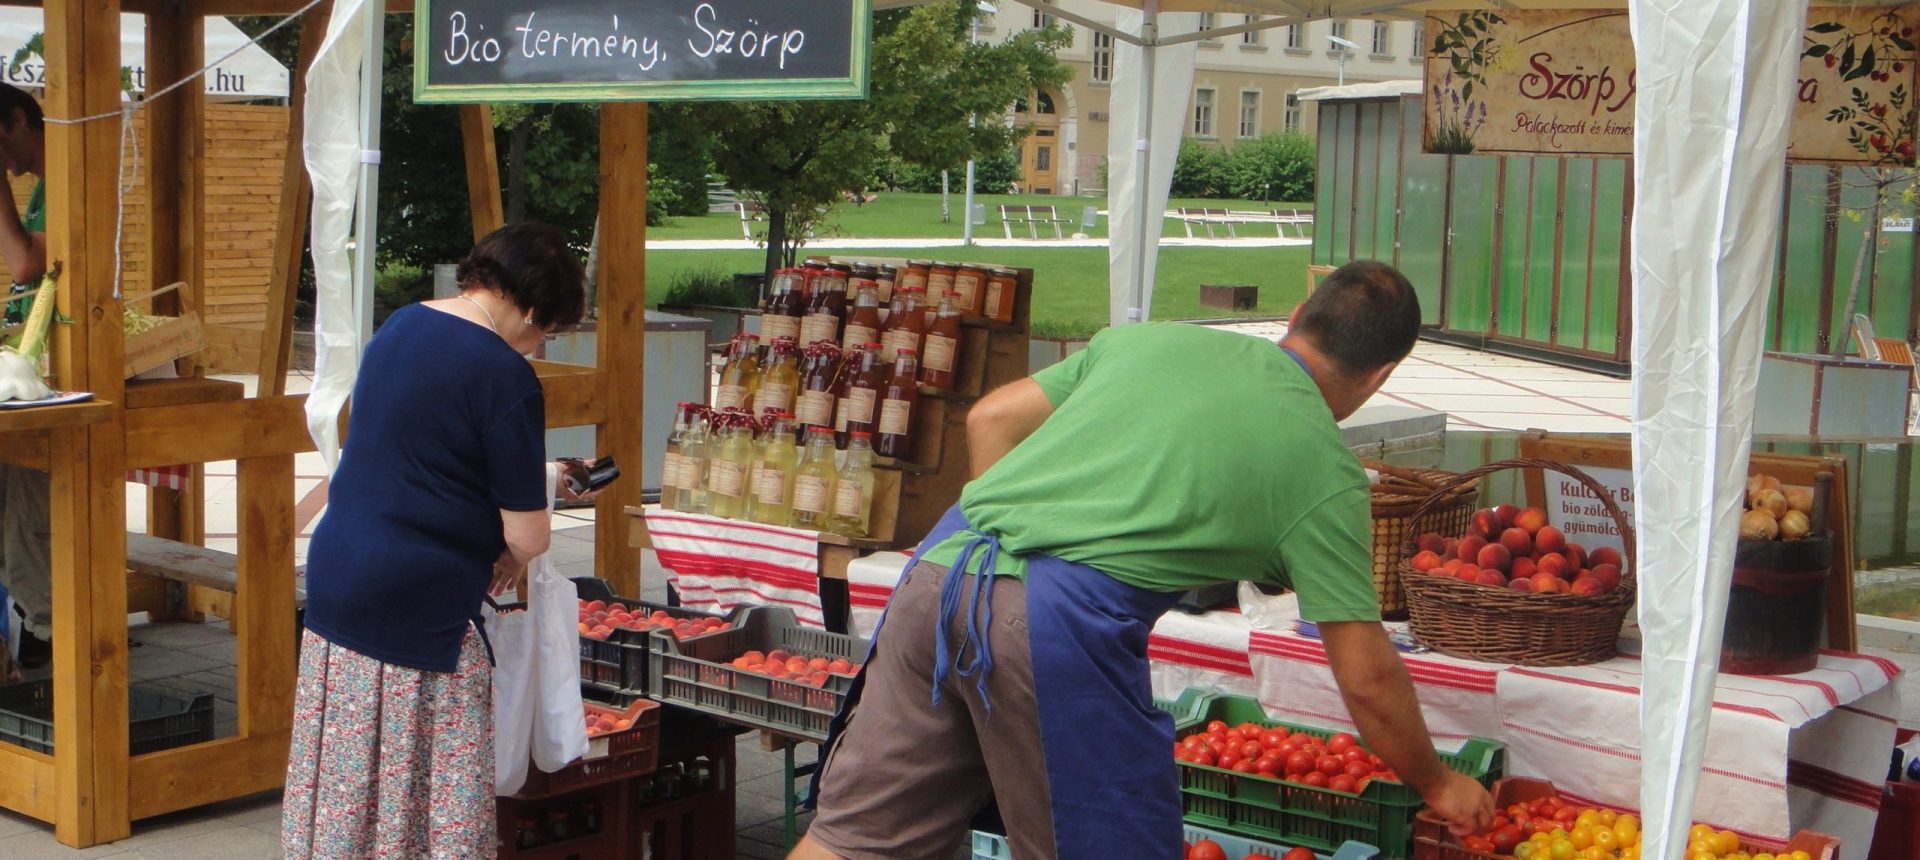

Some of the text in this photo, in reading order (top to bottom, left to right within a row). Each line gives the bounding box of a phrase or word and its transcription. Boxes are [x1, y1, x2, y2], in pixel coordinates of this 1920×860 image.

[445, 3, 805, 71] Bio termény, Szörp
[1519, 52, 1616, 116] Szörp
[1511, 112, 1586, 148] Palackozott
[1590, 120, 1601, 135] és
[1560, 481, 1616, 501] Kulcr
[1562, 500, 1581, 515] bio
